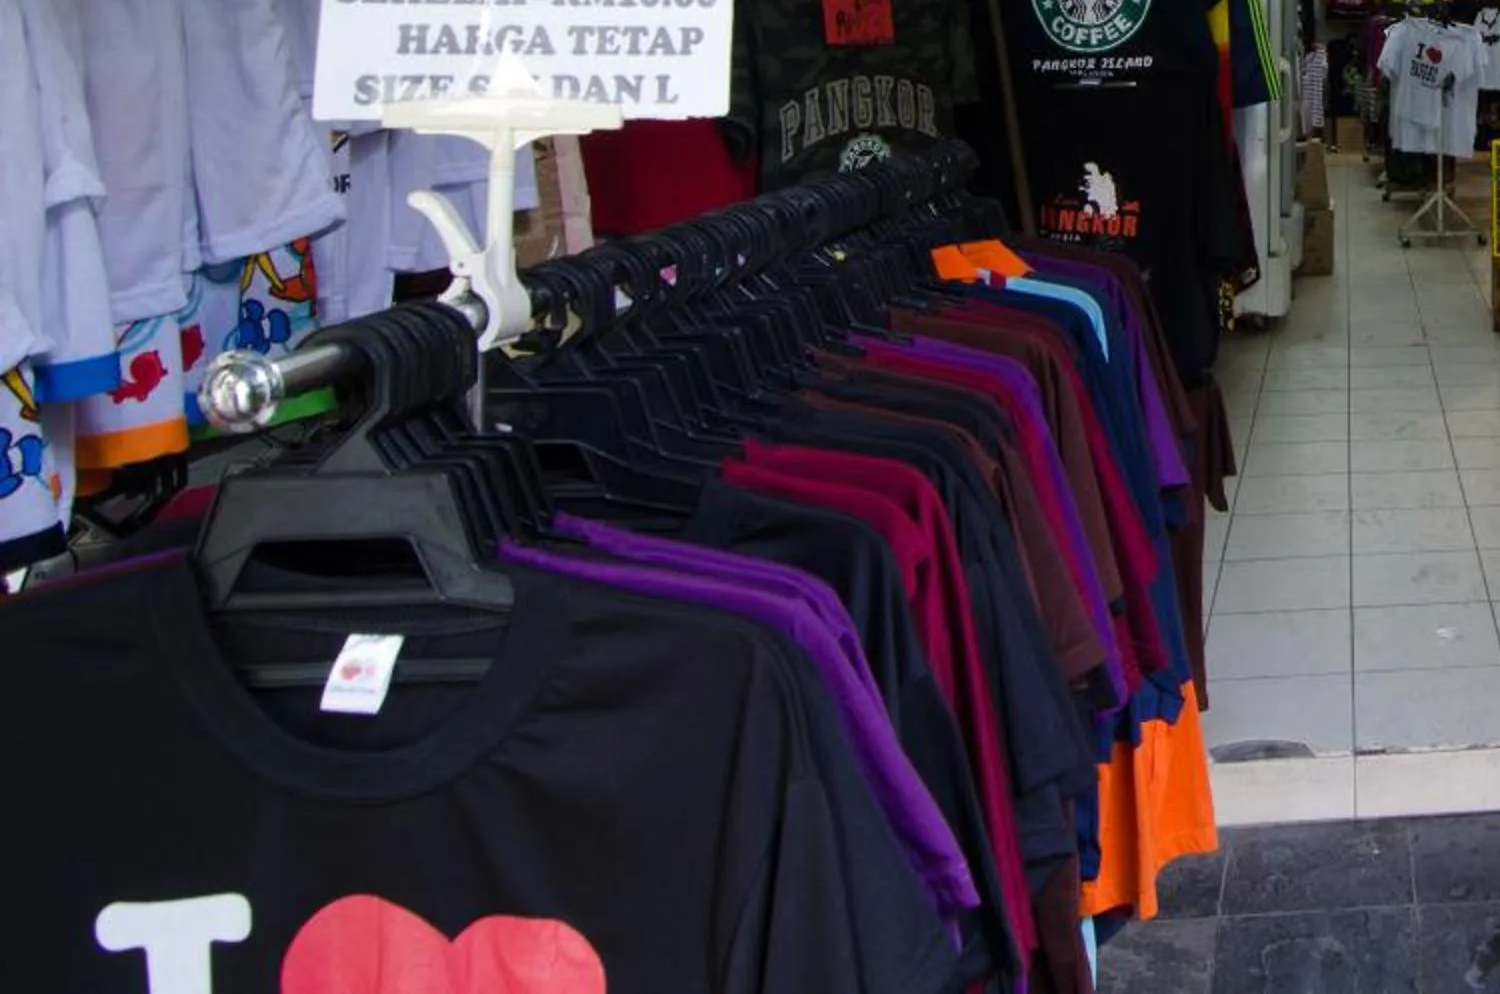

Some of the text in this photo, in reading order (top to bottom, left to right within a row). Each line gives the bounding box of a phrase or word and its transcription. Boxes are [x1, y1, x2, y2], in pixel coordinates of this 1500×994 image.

[396, 23, 705, 57] HARGA TETAP
[1052, 13, 1132, 45] COFFEE
[553, 75, 646, 105] DAN
[656, 76, 679, 104] L
[779, 74, 938, 164] PANGKOR
